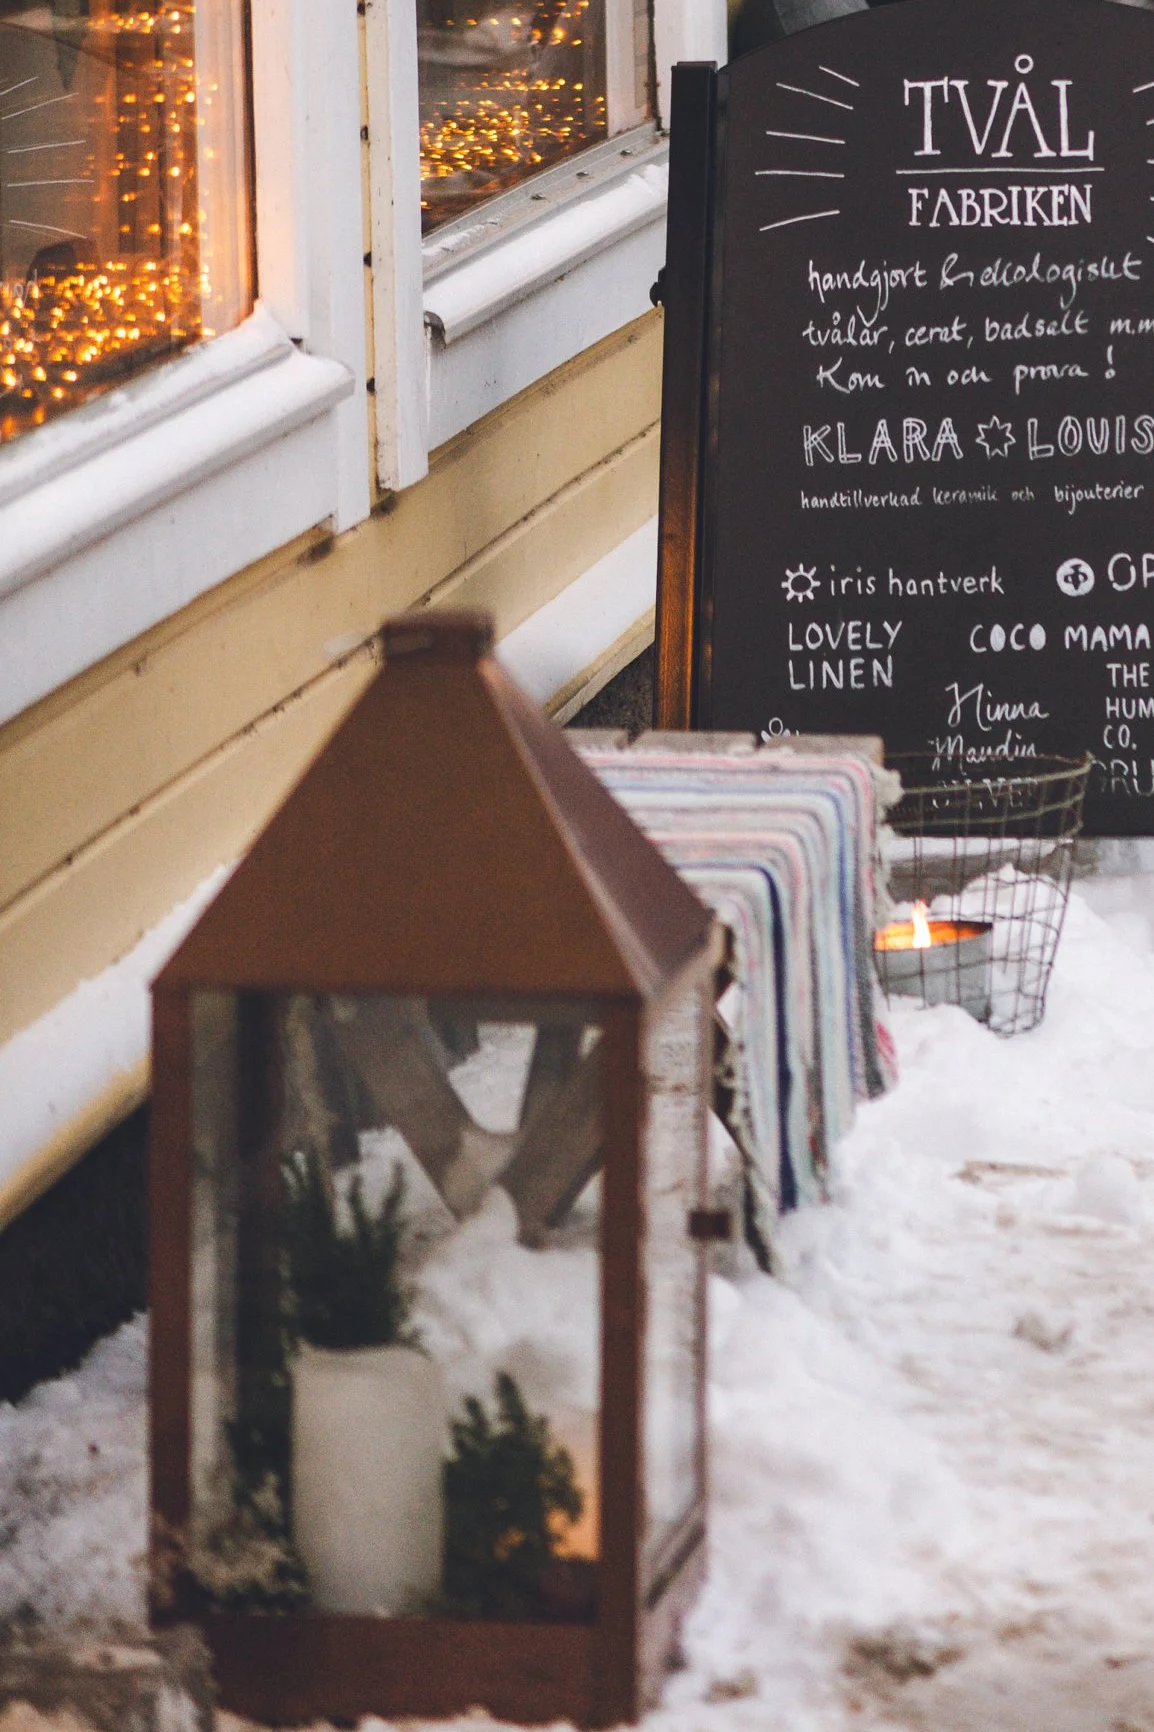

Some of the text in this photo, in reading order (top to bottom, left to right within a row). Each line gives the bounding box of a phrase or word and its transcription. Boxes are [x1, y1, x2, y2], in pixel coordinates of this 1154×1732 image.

[904, 54, 1094, 161] TVÅL
[908, 184, 1093, 227] FABRIKEN
[808, 260, 928, 325] handgjort
[980, 252, 1142, 309] ekologiskt
[985, 310, 1090, 340] badsalt
[816, 357, 885, 394] Kom
[906, 366, 932, 386] in
[947, 367, 992, 385] och
[802, 417, 964, 466] KLARA
[800, 479, 1144, 516] handtillverkad keramik och bijouterier
[830, 564, 1005, 596] iris hantverk
[788, 620, 903, 651] LOVELY
[969, 623, 1152, 653] COCO MAMA
[788, 655, 893, 690] LINEN
[1106, 662, 1150, 688] THE
[1102, 724, 1138, 751] CO.
